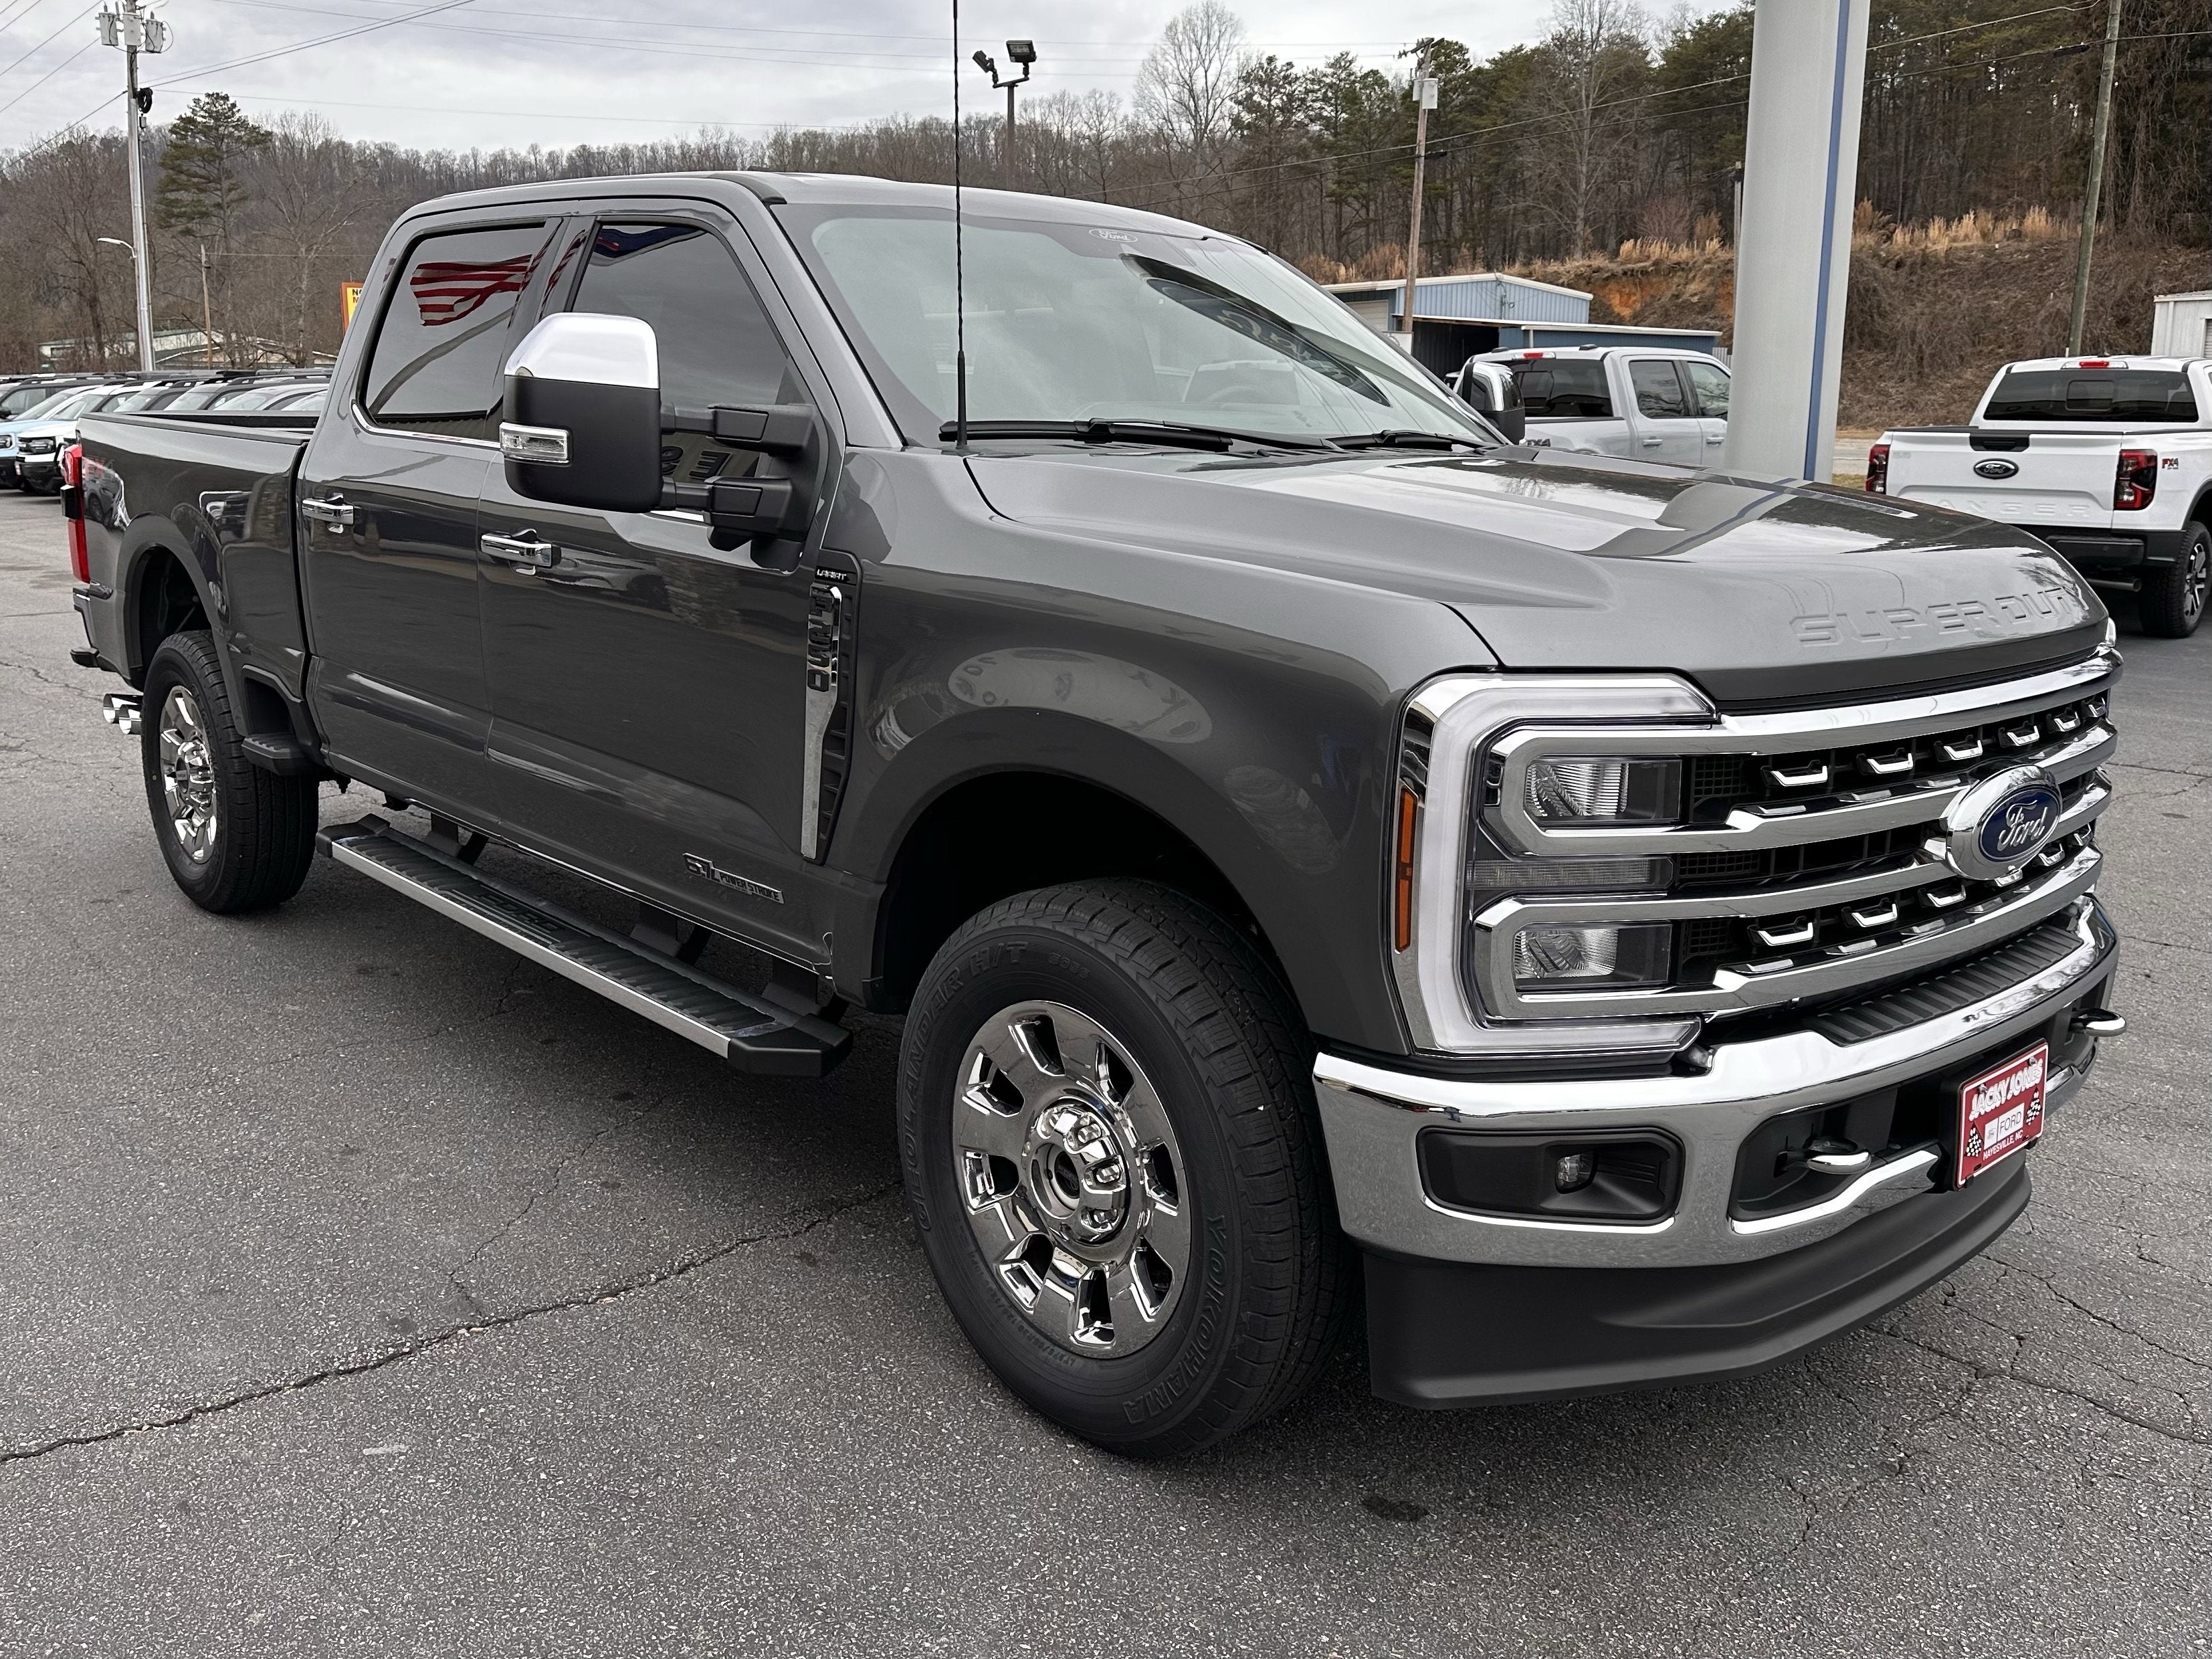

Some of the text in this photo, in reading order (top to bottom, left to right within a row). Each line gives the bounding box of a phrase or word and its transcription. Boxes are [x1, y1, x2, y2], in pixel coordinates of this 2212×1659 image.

[1099, 229, 1130, 241] Ford
[1984, 463, 2007, 474] Ford
[2162, 458, 2179, 469] FX4
[1914, 498, 2090, 518] ANGER
[1790, 586, 2090, 648] SUPER DUTY
[1997, 799, 2049, 852] Ford
[719, 872, 747, 891] POWER
[747, 882, 781, 902] STROKE
[902, 967, 964, 1232] GEOLANDAR
[1969, 1058, 2043, 1122] JACKY JONES
[1999, 1110, 2022, 1135] FORD
[1983, 1135, 2015, 1161] HAYESVILLE,
[2015, 1129, 2023, 1141] NC
[1122, 1214, 1228, 1426] YOKOHAMA
